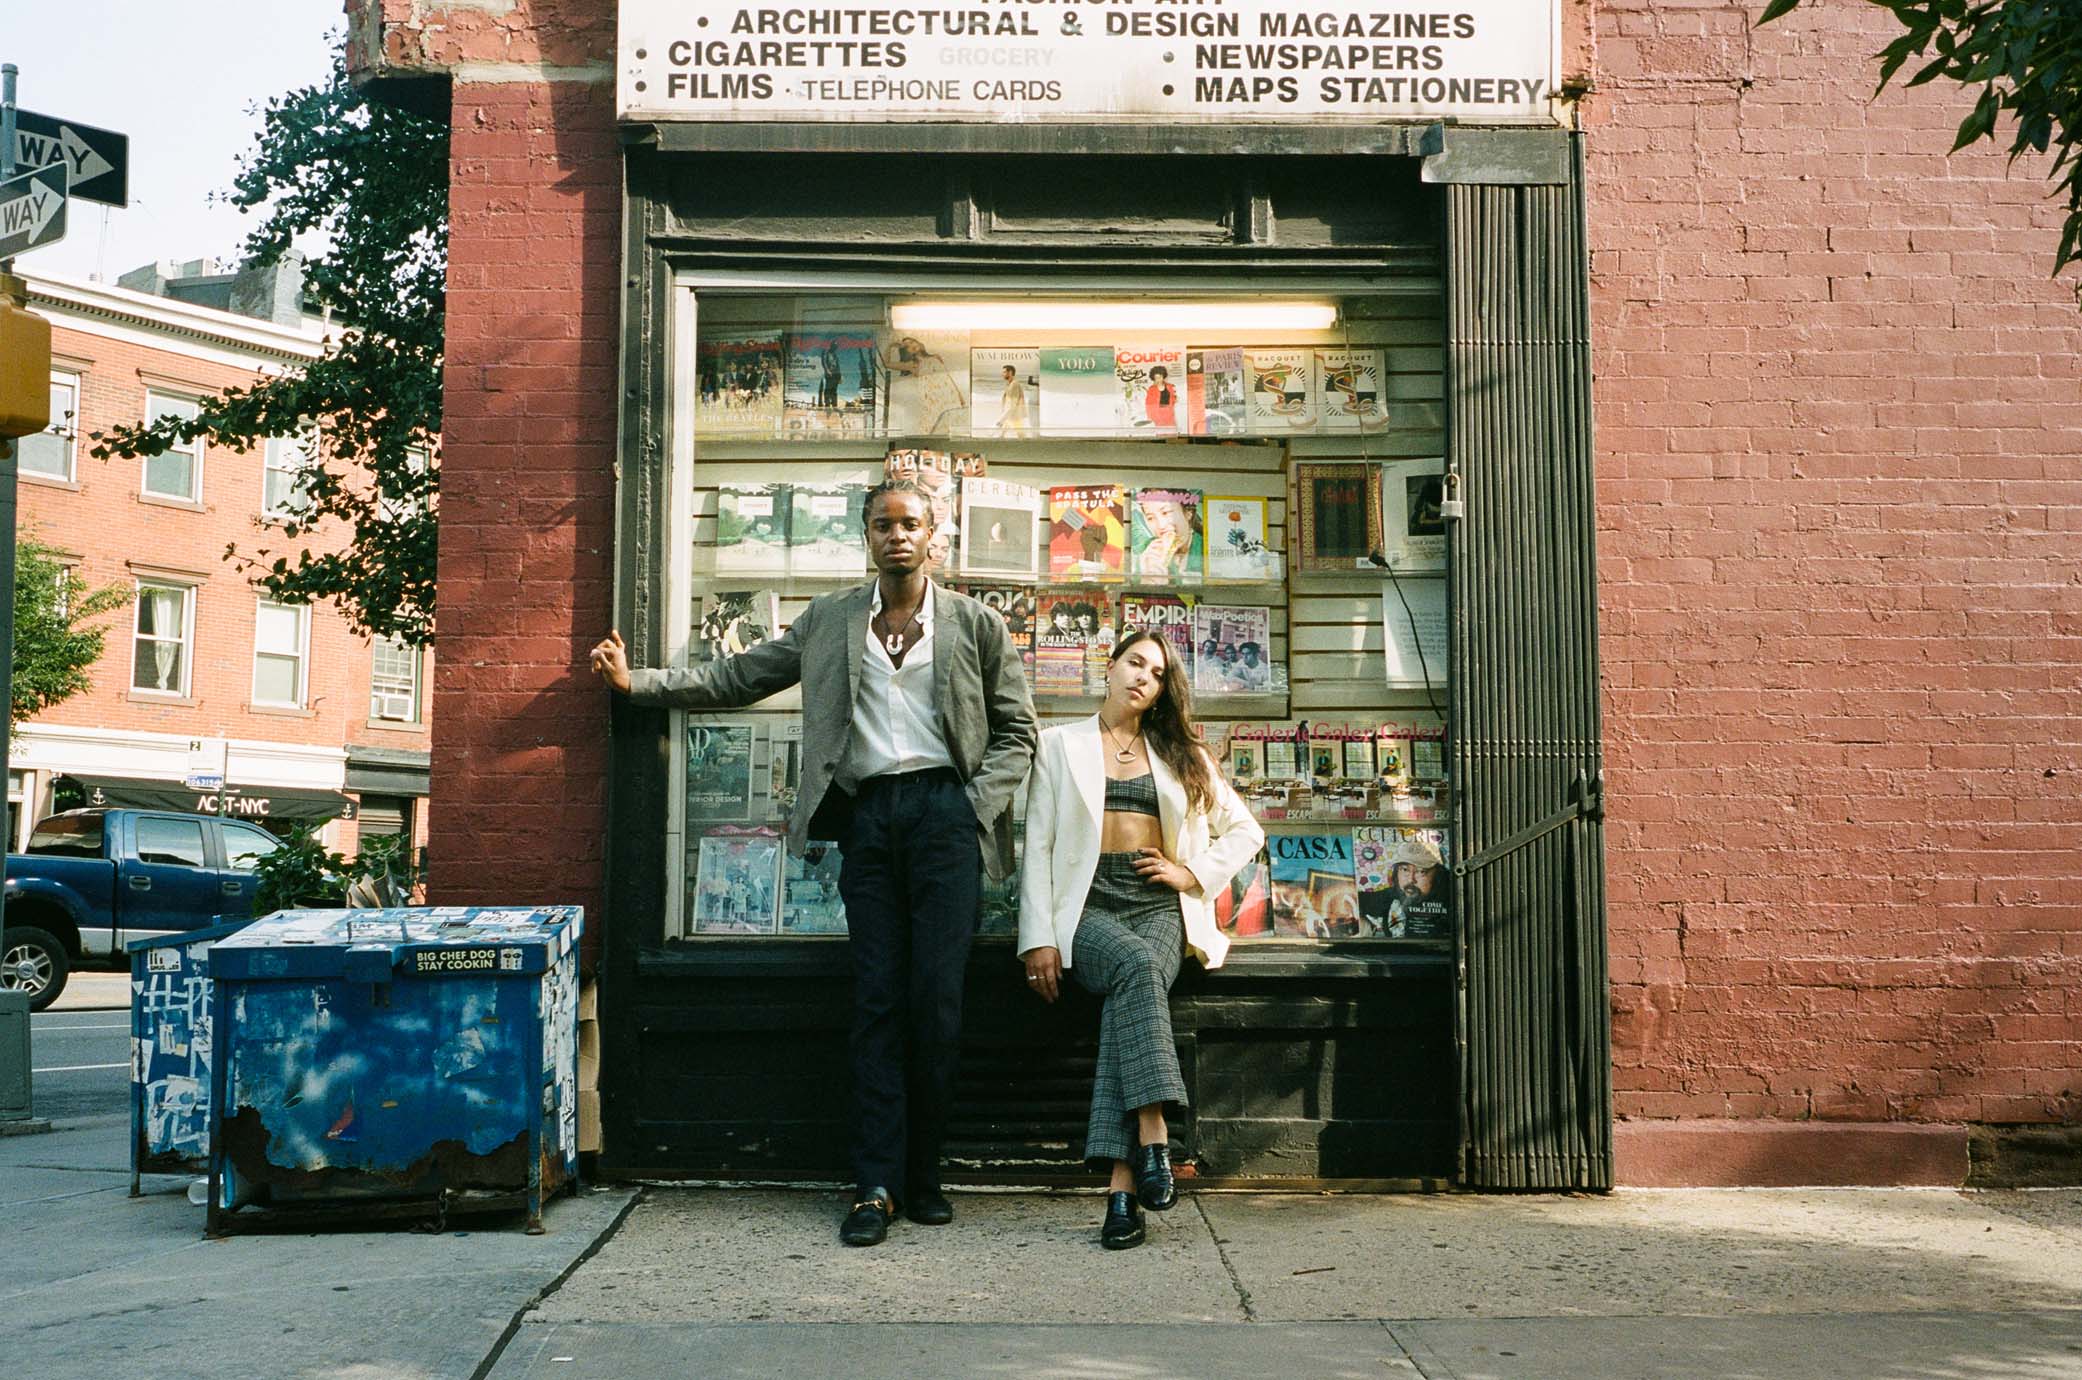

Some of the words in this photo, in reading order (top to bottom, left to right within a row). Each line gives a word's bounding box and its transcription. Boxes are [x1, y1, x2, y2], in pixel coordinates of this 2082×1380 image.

[731, 9, 1038, 36] ARCHITECTURAL
[1060, 10, 1083, 36] &
[1106, 12, 1239, 37] DESIGN
[1260, 12, 1475, 39] MAGAZINES
[668, 41, 907, 67] CIGARETTES
[939, 47, 1054, 66] GROCERY
[1196, 44, 1443, 70] NEWSPAPERS
[668, 74, 773, 99] FILMS
[802, 79, 960, 100] TELEPHONE
[973, 80, 1062, 101] CARDS
[1195, 76, 1299, 103] MAPS
[1320, 77, 1544, 104] STATIONERY
[20, 134, 91, 175] WAY
[4, 191, 48, 234] WAY
[1058, 358, 1096, 370] YOLO
[1119, 349, 1181, 363] Courier
[890, 455, 980, 473] HOLIDAY
[967, 481, 1035, 498] CEREAL
[1055, 491, 1088, 500] PASS
[1092, 489, 1120, 499] THE
[1277, 837, 1347, 860] CASA
[417, 952, 437, 961] BIG
[440, 951, 467, 961] CHEF
[470, 950, 496, 959] DOG
[417, 961, 444, 971] STAY
[447, 959, 494, 970] COOKIN
